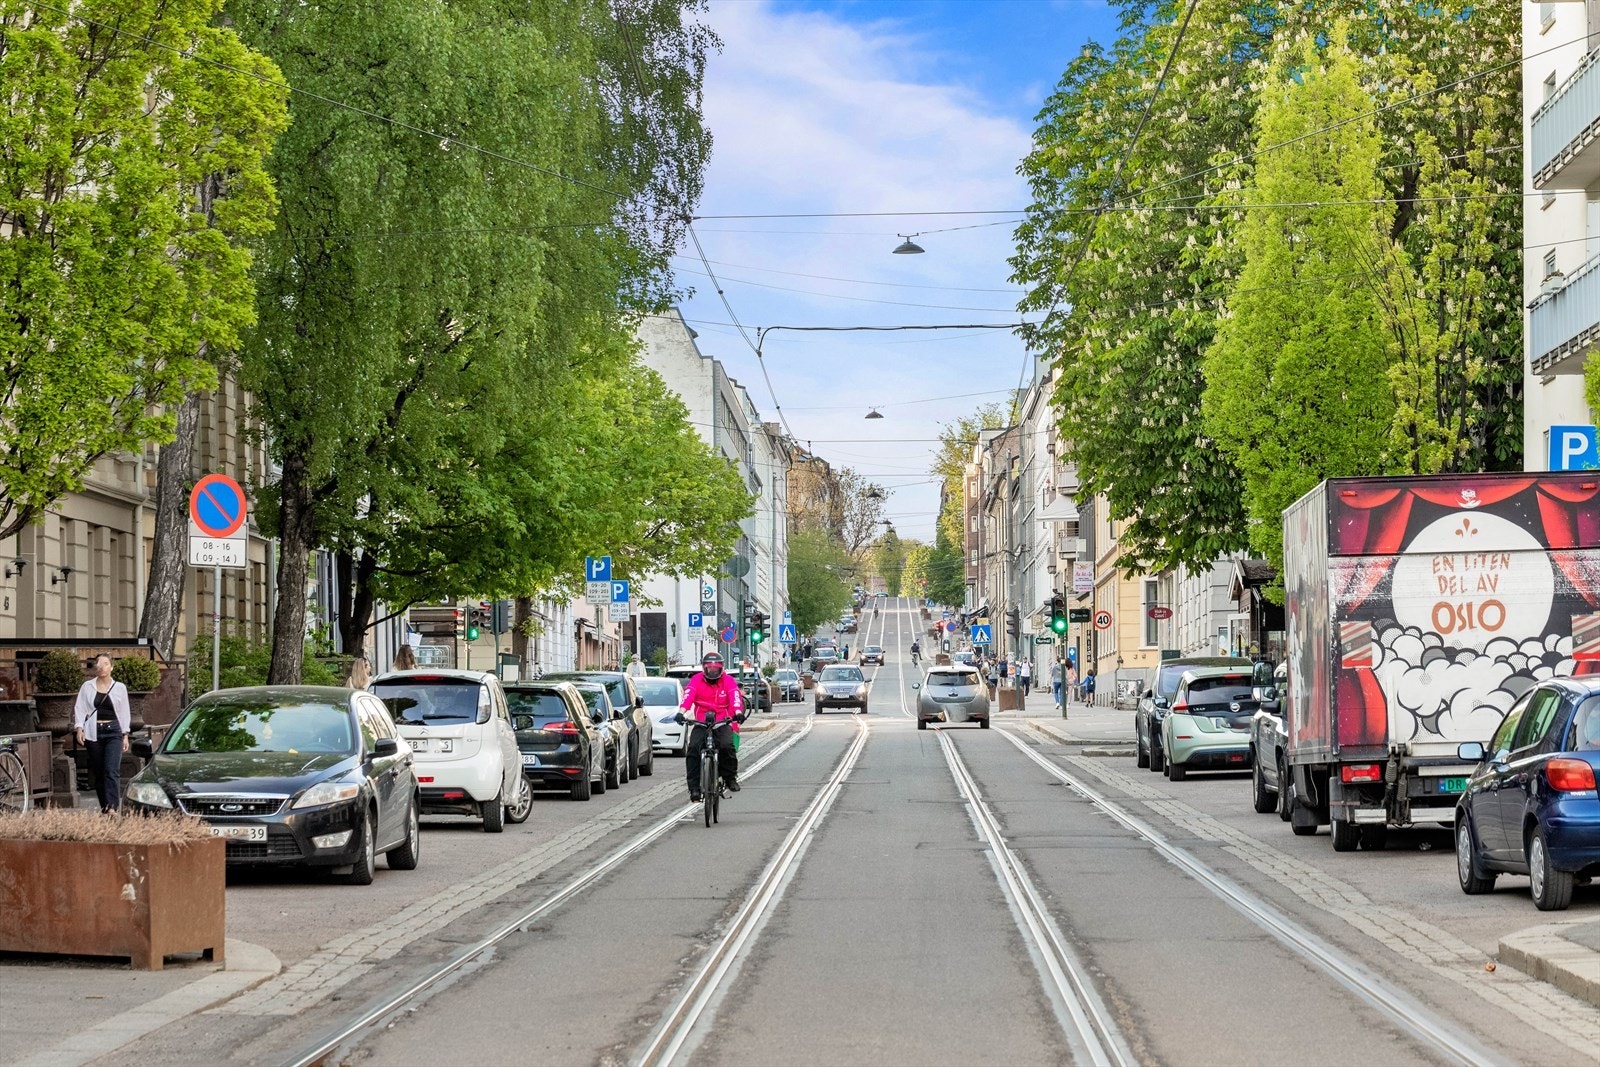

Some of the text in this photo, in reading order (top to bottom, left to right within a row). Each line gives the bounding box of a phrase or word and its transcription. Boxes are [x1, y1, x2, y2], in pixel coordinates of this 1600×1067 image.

[1562, 432, 1589, 470] P
[592, 560, 605, 579] P
[1432, 555, 1454, 574] EN
[613, 583, 624, 600] P
[1437, 573, 1499, 596] DEL AV
[692, 615, 700, 625] P
[1097, 615, 1109, 625] 40
[1431, 599, 1507, 634] OSLO
[1448, 780, 1462, 790] DR
[250, 828, 265, 839] 39
